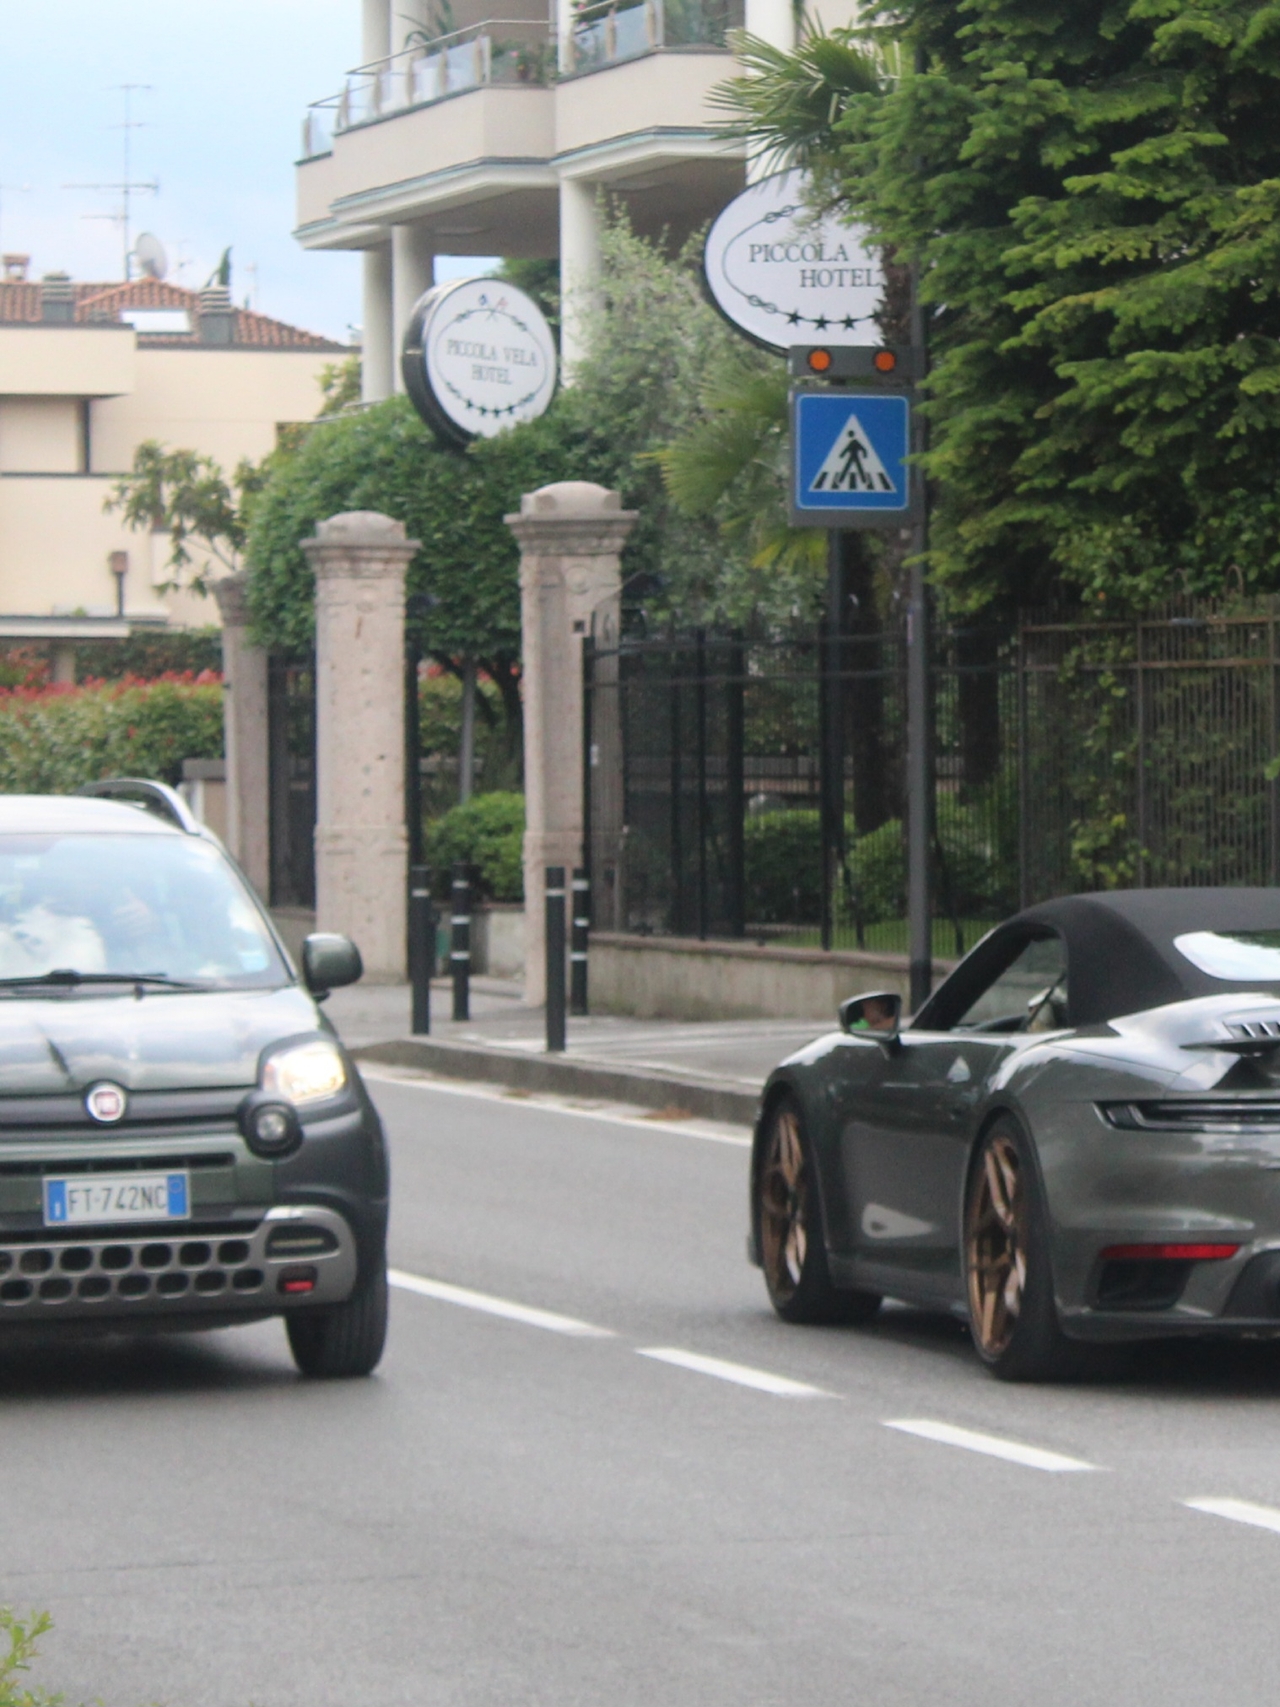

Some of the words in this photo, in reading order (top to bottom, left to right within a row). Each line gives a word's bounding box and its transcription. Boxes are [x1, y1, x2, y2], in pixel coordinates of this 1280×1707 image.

[749, 243, 848, 263] PICCOLA
[800, 268, 880, 288] HOTEL
[446, 339, 497, 361] PICCOLA
[503, 347, 538, 367] VELA
[472, 364, 513, 385] HOTEL
[68, 1188, 92, 1213] FT
[101, 1185, 166, 1212] 742NC
